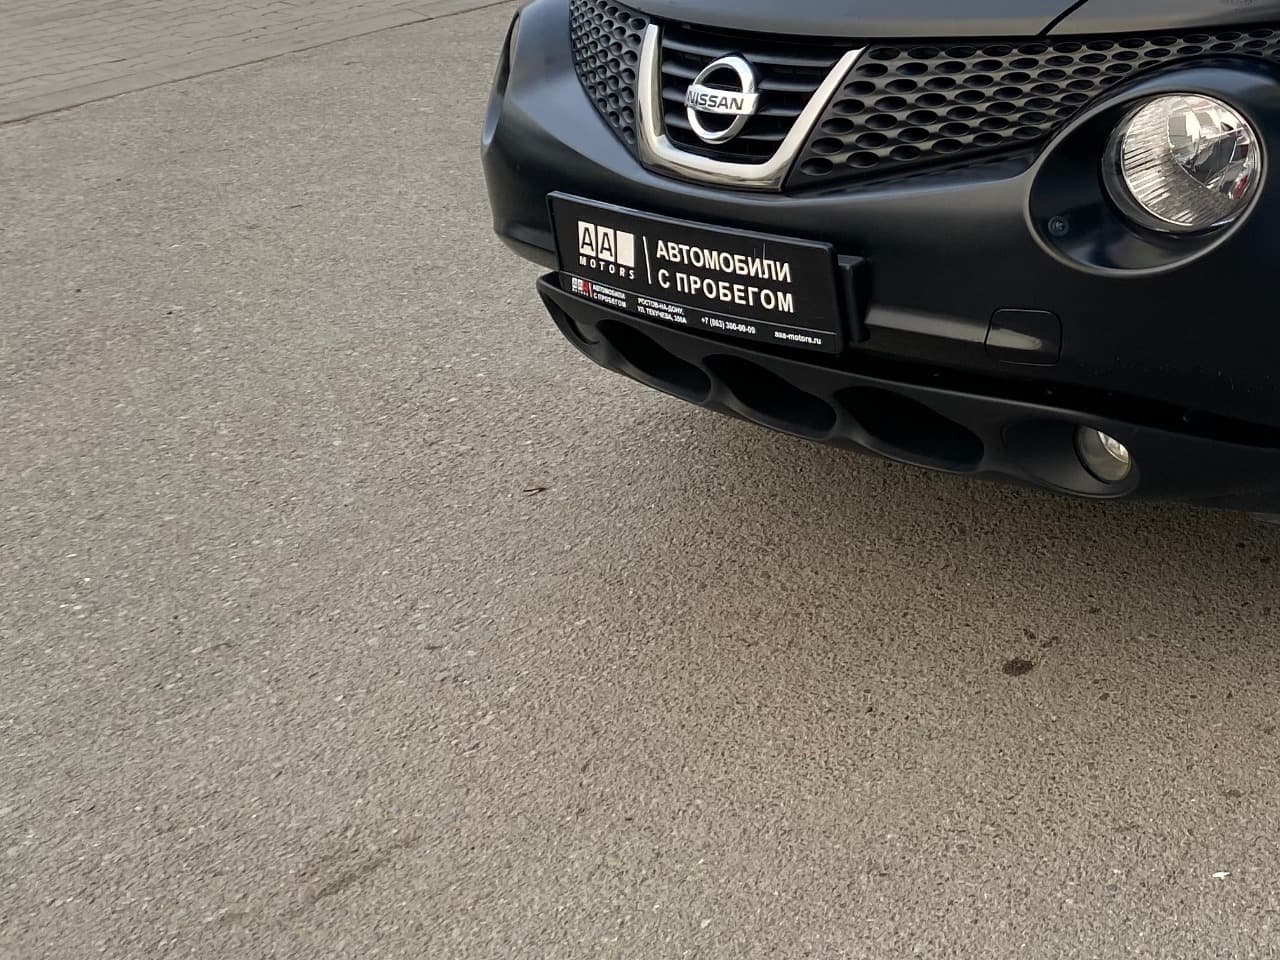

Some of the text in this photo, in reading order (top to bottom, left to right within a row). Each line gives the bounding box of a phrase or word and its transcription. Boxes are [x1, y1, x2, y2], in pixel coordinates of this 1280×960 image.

[687, 90, 744, 111] NISSAN
[579, 255, 635, 280] MOTORS
[656, 239, 792, 283] АВТОМОБИЛИ
[657, 268, 794, 313] С ПРОБЕГОМ
